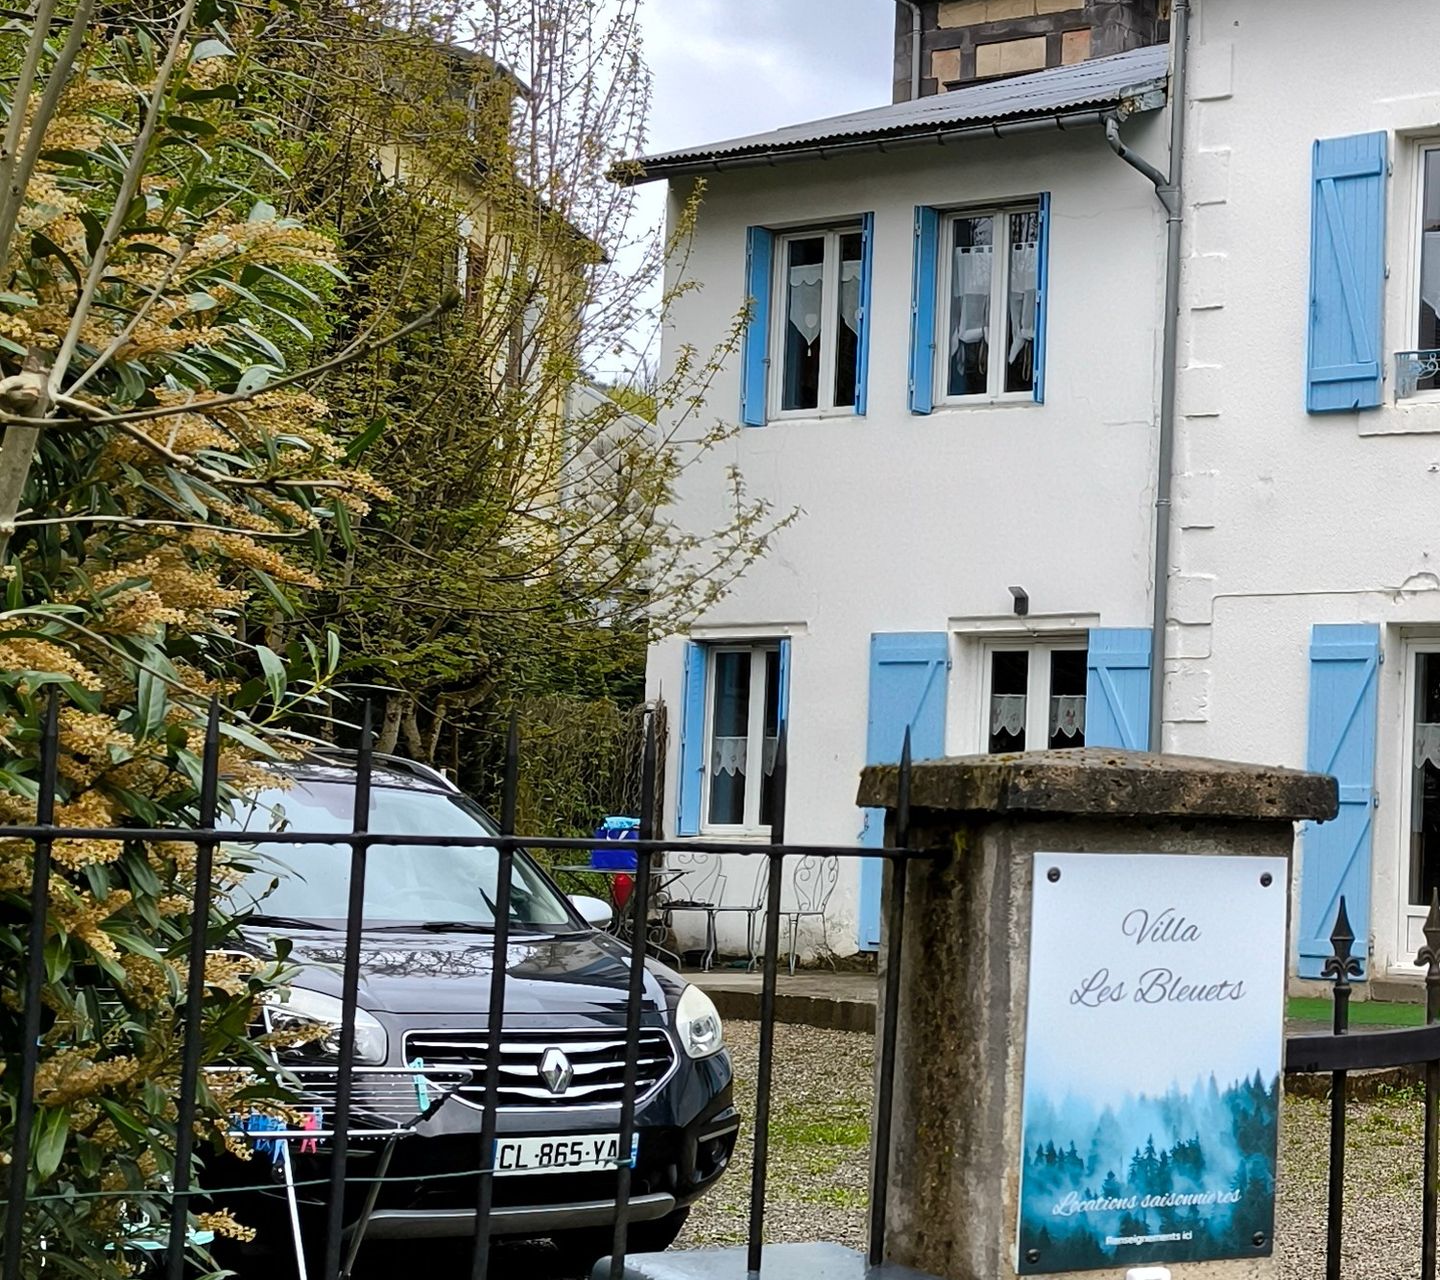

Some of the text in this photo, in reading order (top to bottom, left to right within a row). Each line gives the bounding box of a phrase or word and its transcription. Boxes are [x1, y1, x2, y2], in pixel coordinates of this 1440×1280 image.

[1121, 907, 1203, 945] Villa
[1069, 967, 1246, 1008] Les Bleuets
[1052, 1191, 1139, 1217] Locations
[1182, 1230, 1193, 1241] ici
